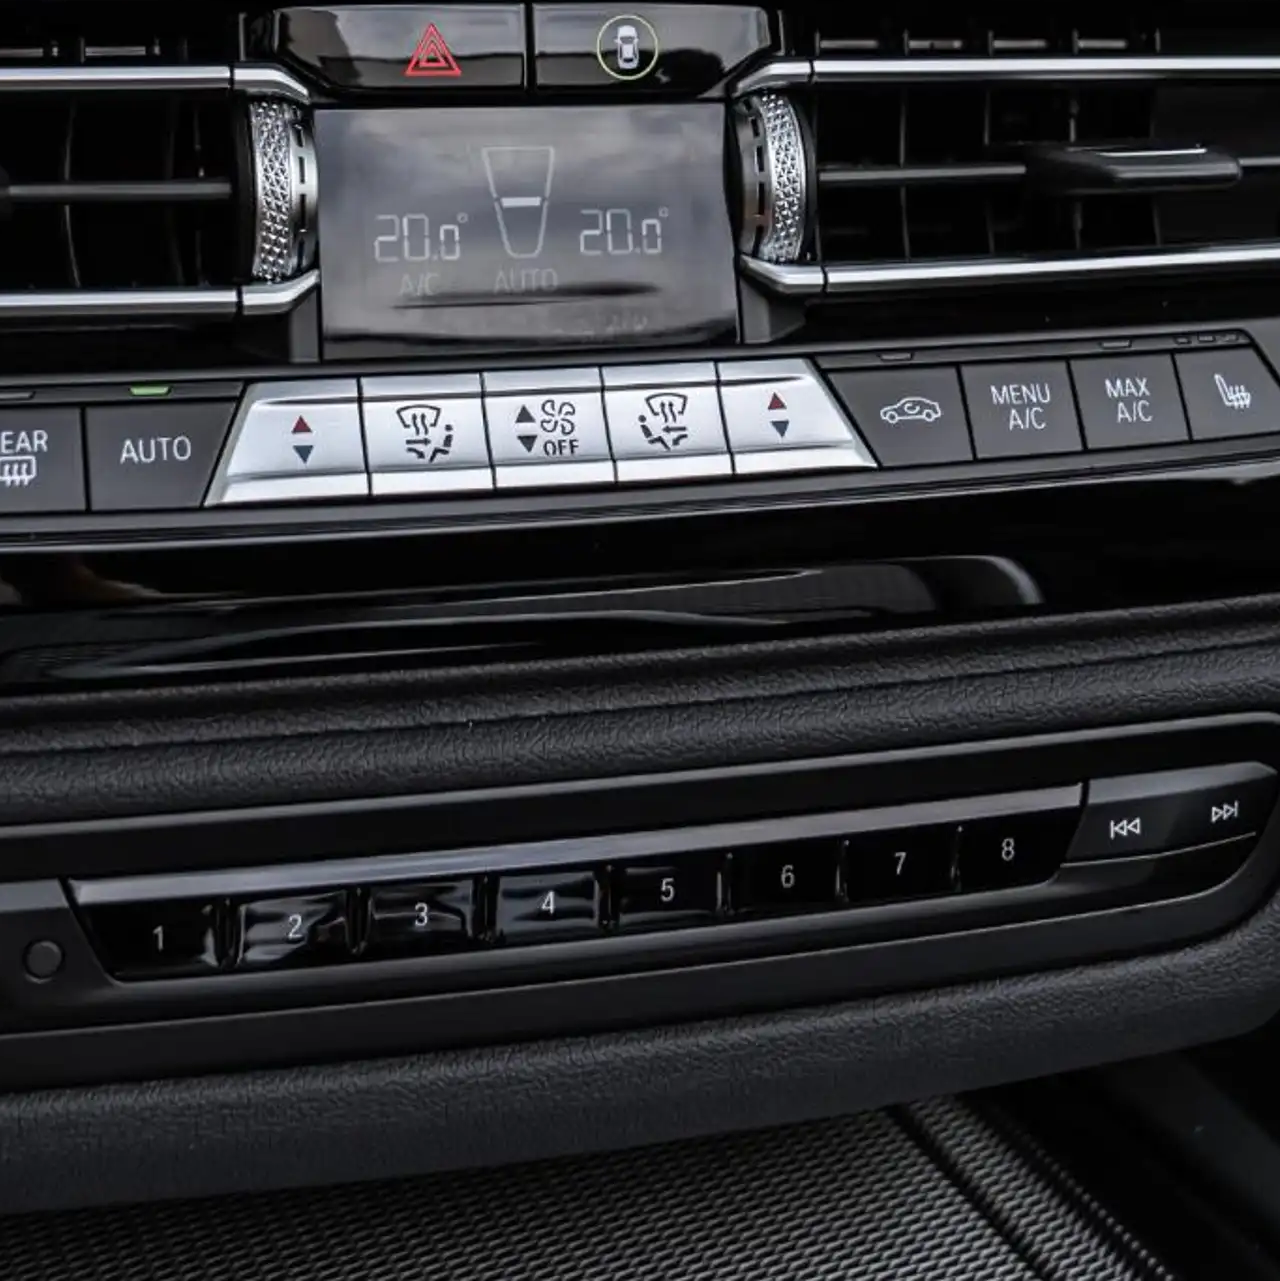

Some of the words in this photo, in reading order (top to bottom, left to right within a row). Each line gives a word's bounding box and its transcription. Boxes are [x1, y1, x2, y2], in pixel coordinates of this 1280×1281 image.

[399, 272, 441, 297] A/C
[493, 268, 559, 294] AUTO
[990, 382, 1052, 406] MENU
[1104, 376, 1151, 400] MAX
[1008, 407, 1047, 431] A/C
[1116, 400, 1153, 423] A/C
[120, 436, 192, 465] AUTO
[543, 436, 580, 457] OFF
[152, 925, 164, 952] 1
[287, 915, 303, 941] 2
[413, 902, 429, 928] 3
[540, 890, 556, 915] 4
[660, 878, 675, 902] 5
[780, 864, 795, 888] 6
[894, 851, 908, 876] 7
[1001, 837, 1016, 861] 8
